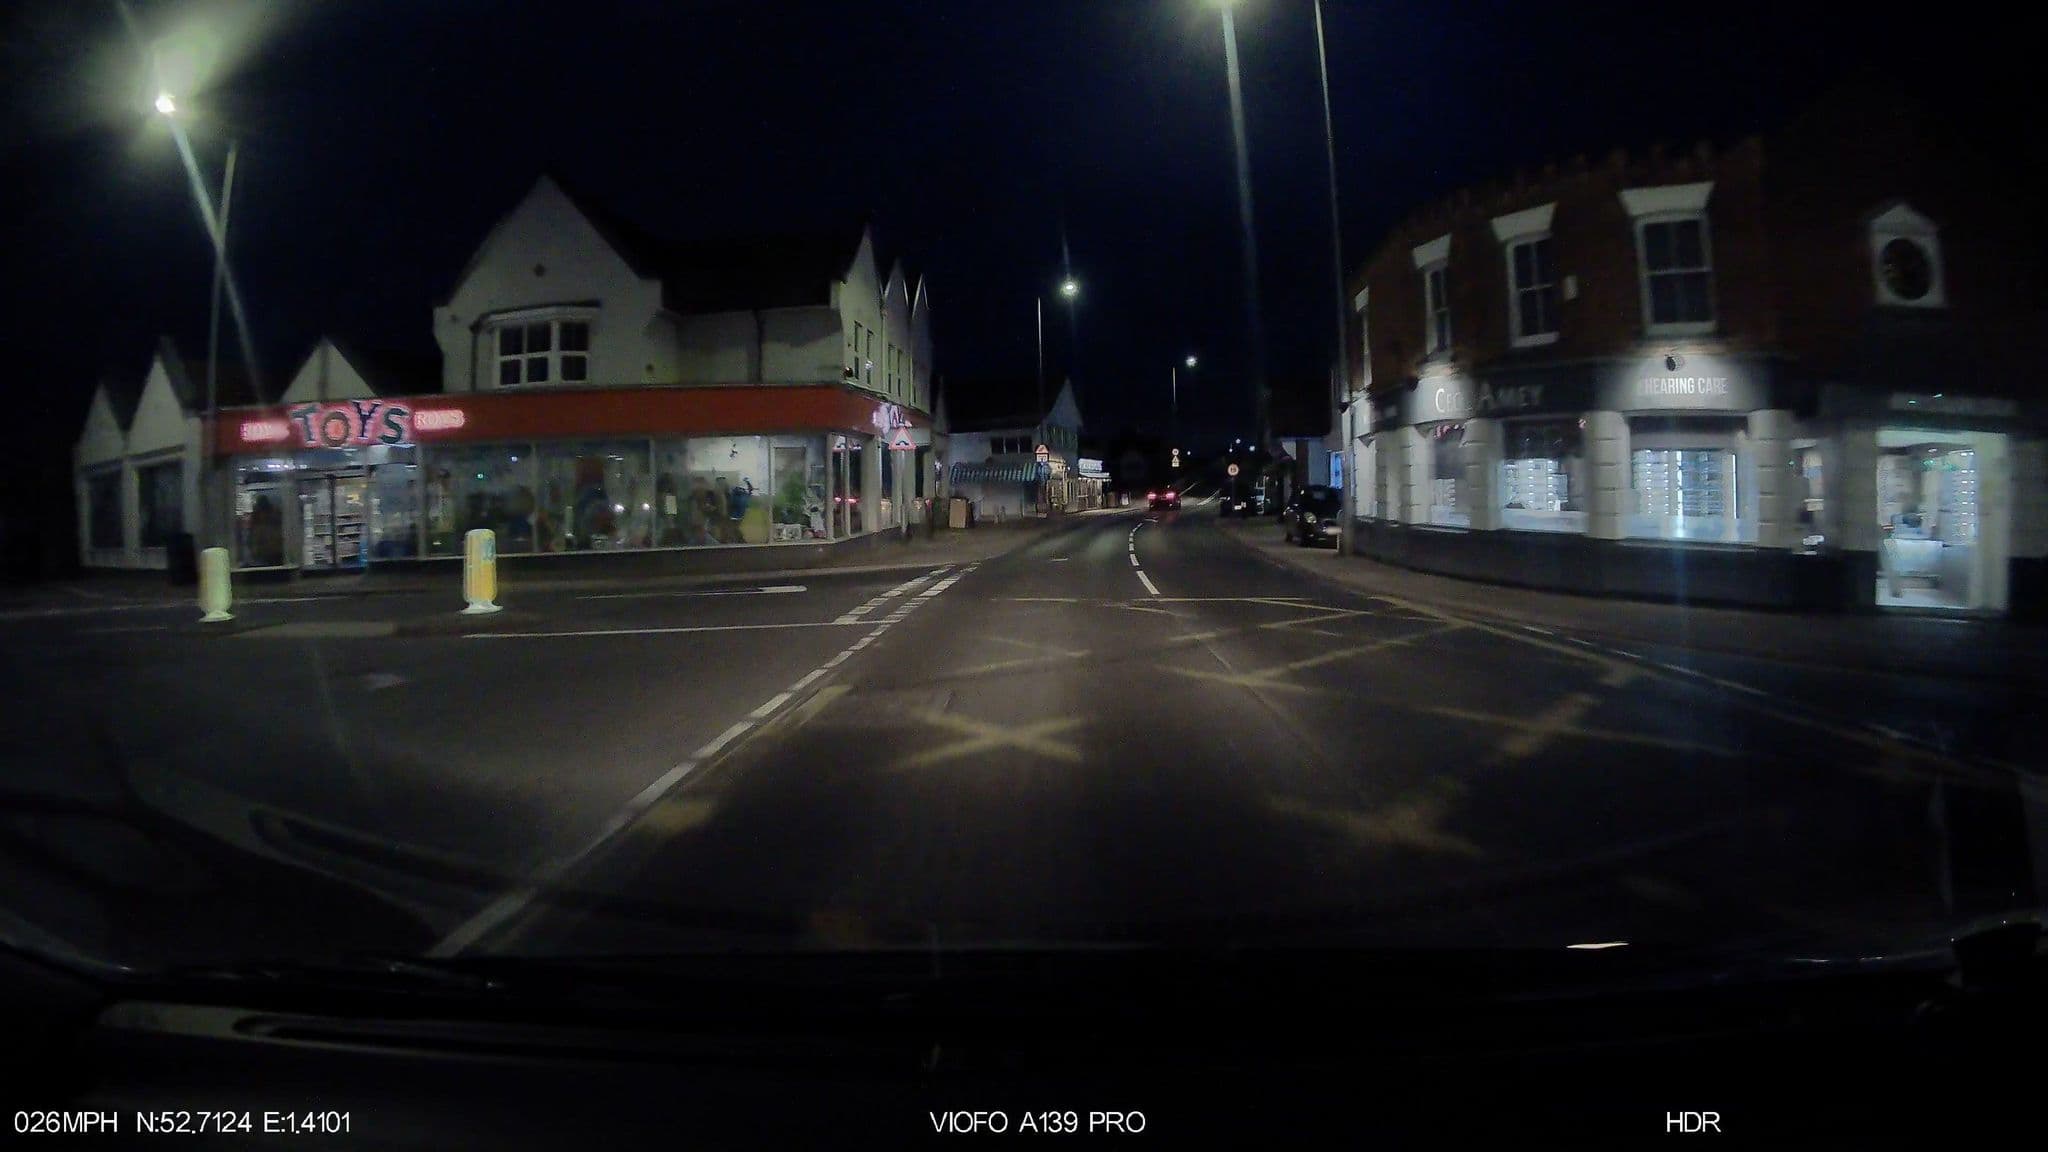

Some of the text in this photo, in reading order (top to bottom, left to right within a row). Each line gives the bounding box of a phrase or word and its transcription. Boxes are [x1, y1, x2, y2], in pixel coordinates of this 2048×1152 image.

[1644, 376, 1729, 394] HEARING CARE
[290, 400, 411, 448] TOYS
